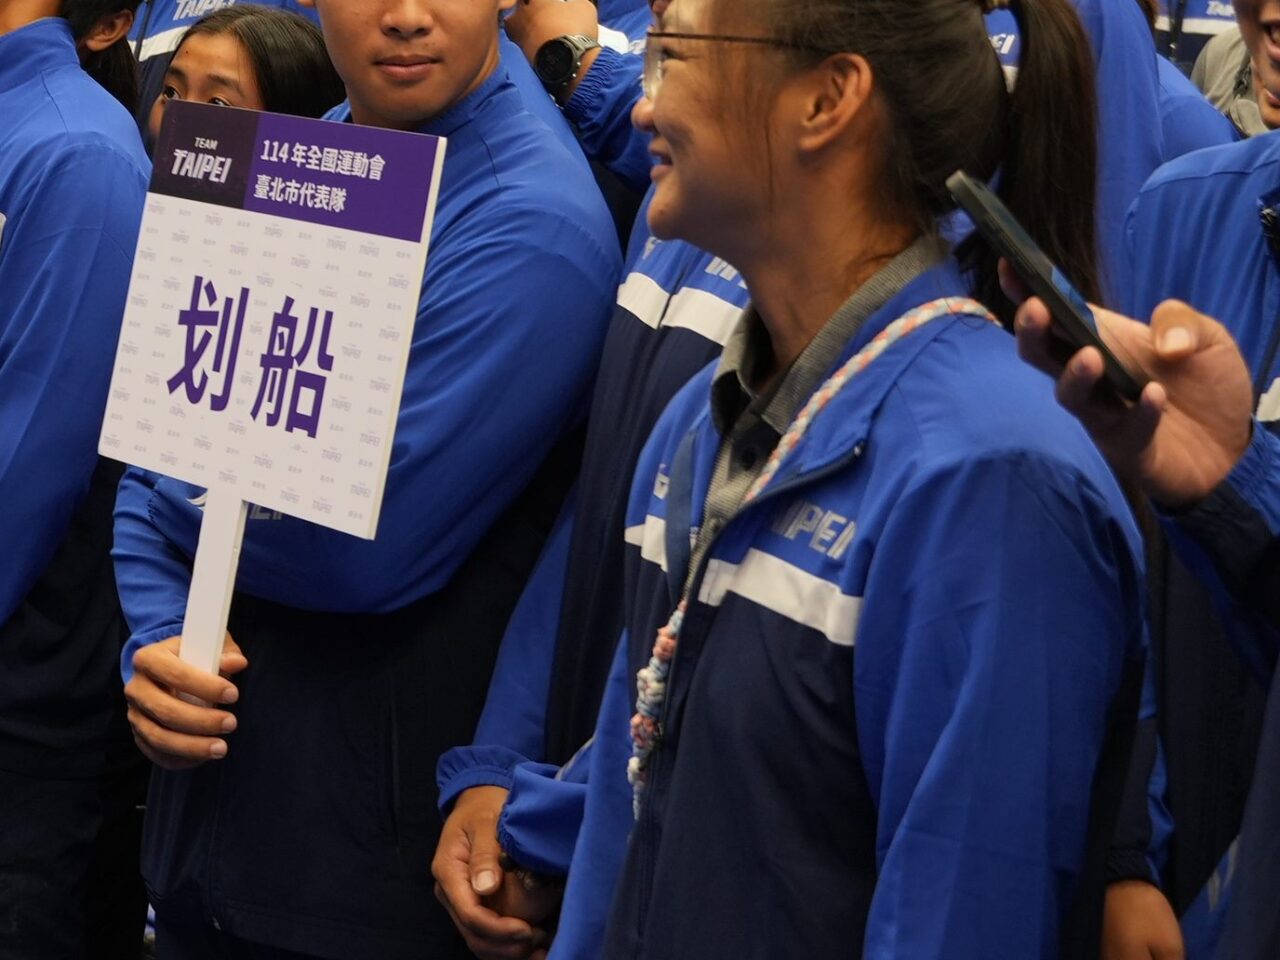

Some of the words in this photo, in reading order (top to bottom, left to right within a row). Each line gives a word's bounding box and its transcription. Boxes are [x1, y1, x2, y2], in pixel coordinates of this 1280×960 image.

[194, 136, 218, 150] TEAM
[171, 148, 233, 184] TAIPEI
[253, 173, 348, 213] 臺北市代表隊
[166, 275, 335, 439] 划船
